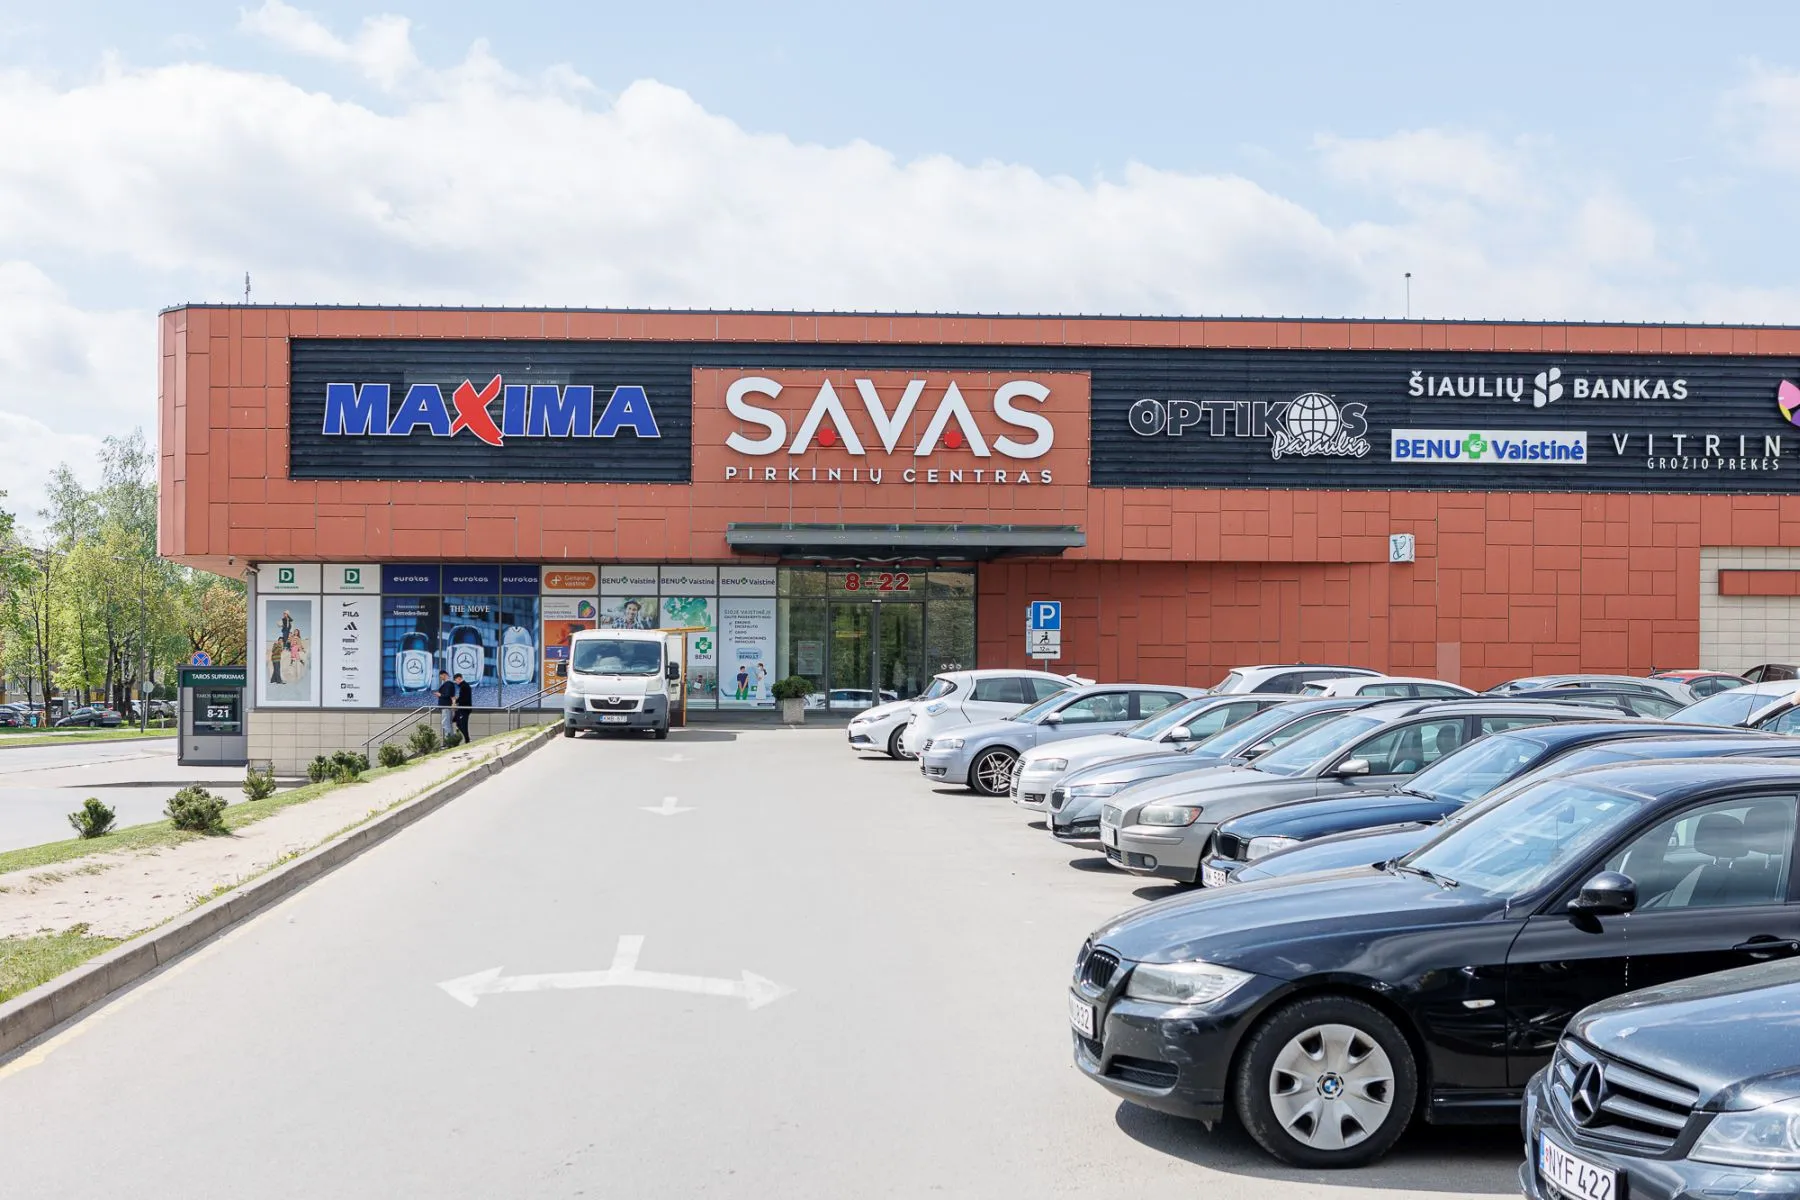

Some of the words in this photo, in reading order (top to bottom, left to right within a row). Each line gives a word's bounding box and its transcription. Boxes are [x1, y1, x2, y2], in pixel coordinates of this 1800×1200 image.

[1408, 371, 1524, 402] ŠIAULIŲ
[1573, 379, 1688, 400] BANKAS
[322, 374, 661, 446] MAXIMA
[725, 377, 1054, 459] SAVAS
[1271, 431, 1371, 460] Pasaulis
[1395, 439, 1461, 459] BENU
[1491, 439, 1584, 460] Vaistinė
[1612, 433, 1781, 457] VITRIN
[1647, 456, 1709, 470] GROŽIO
[1718, 457, 1779, 470] PREKĖS
[725, 466, 883, 485] PIRKINIŲ
[903, 468, 1053, 485] CENTRAS
[281, 569, 294, 581] D
[346, 570, 359, 582] D
[630, 577, 656, 585] Vaistinė
[749, 578, 776, 586] Vaistinė
[450, 605, 465, 613] THE
[467, 605, 490, 613] MOVE
[1040, 605, 1055, 627] P
[207, 709, 229, 718] 8-21
[1549, 1145, 1574, 1185] NYF
[1578, 1165, 1611, 1200] 422
